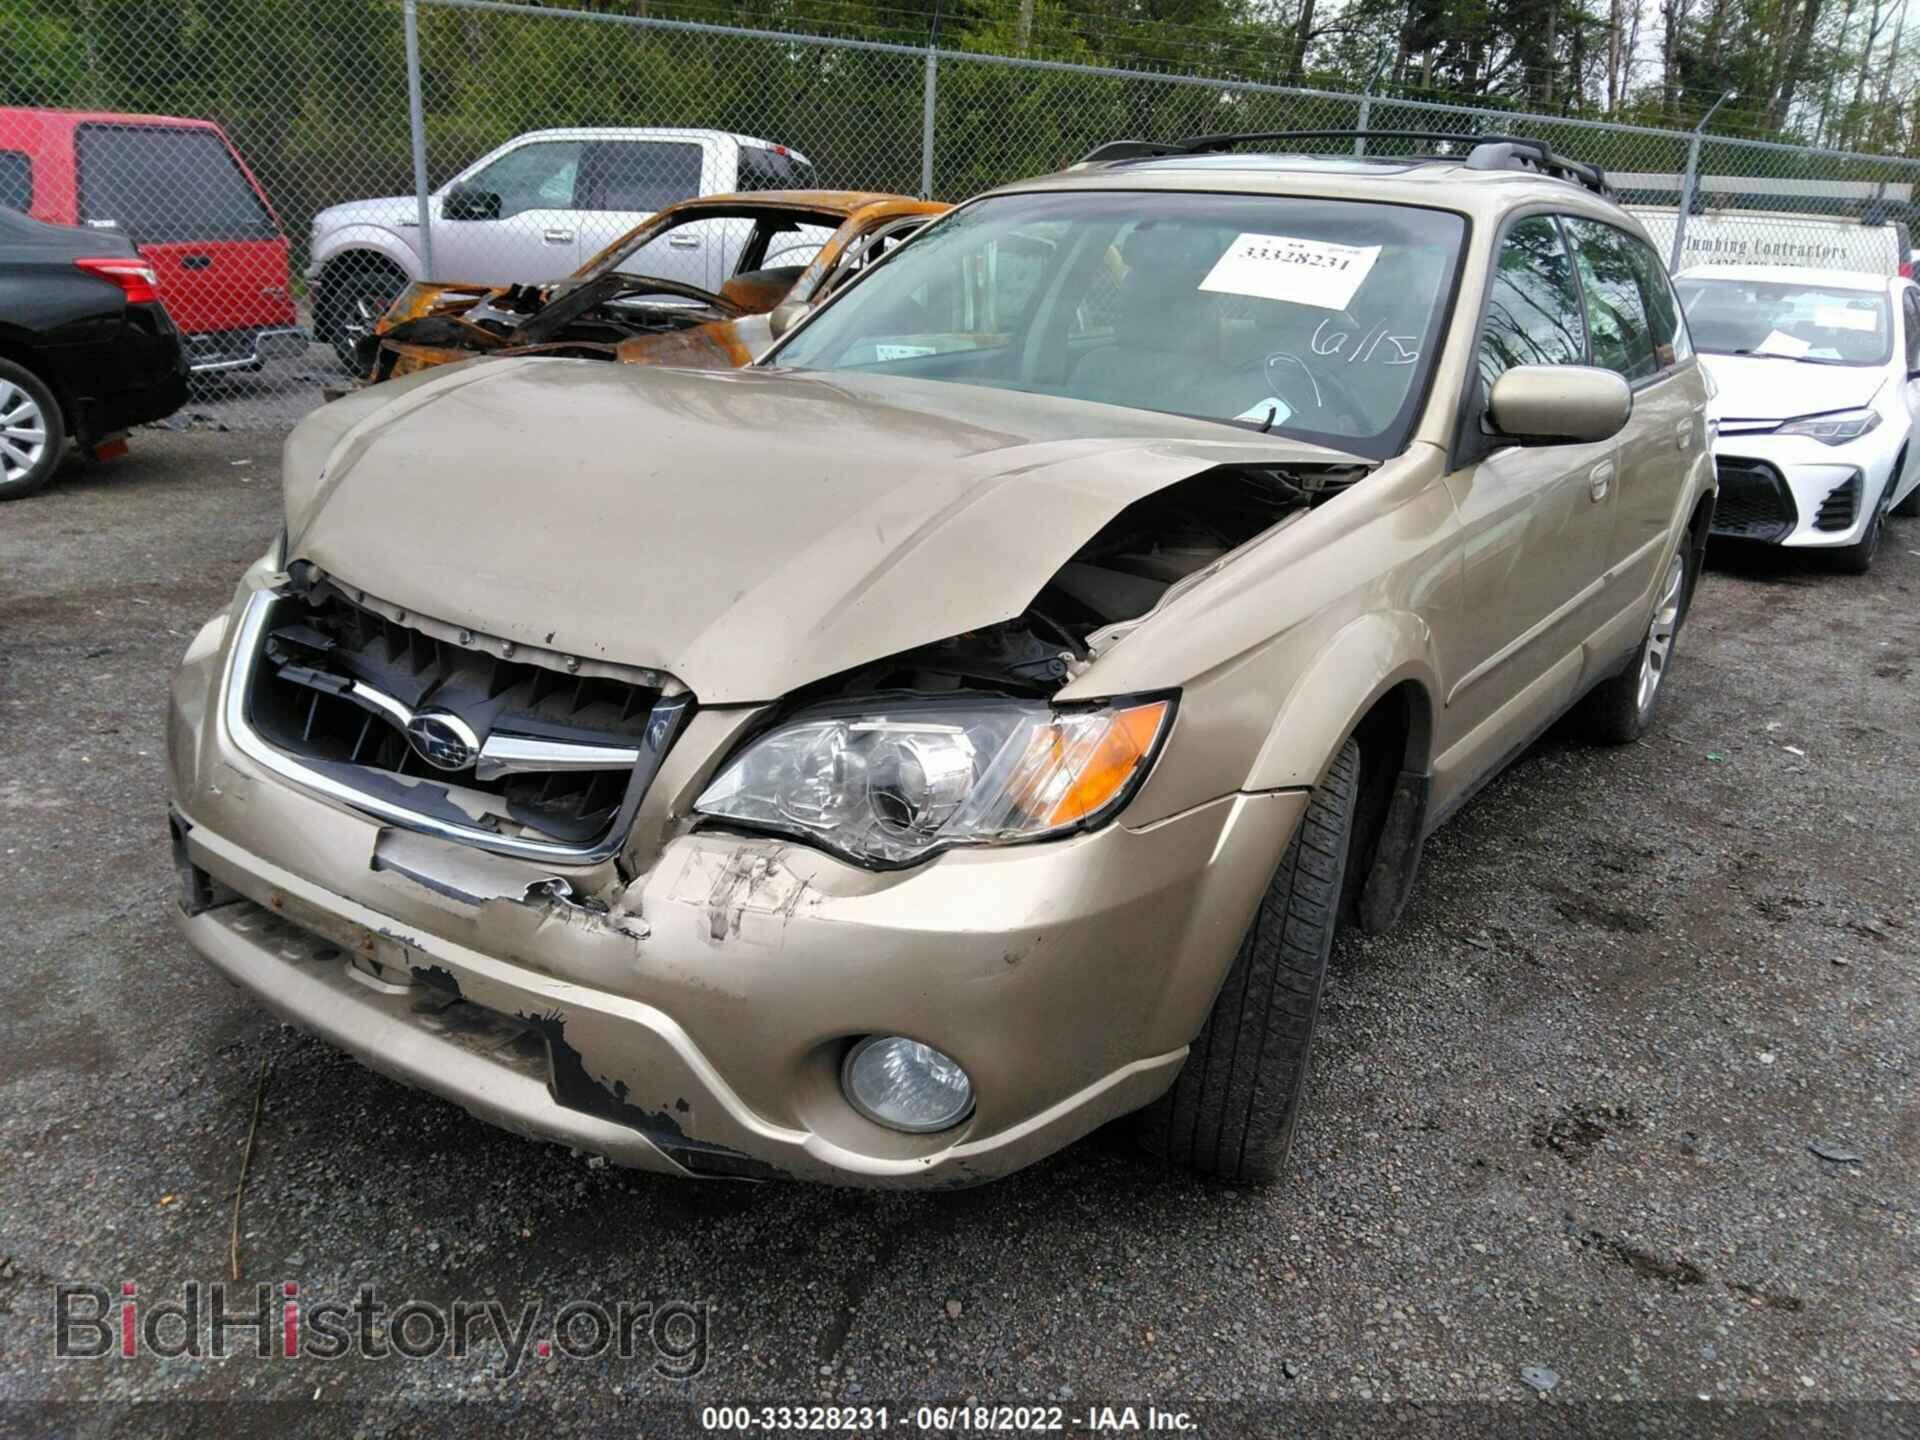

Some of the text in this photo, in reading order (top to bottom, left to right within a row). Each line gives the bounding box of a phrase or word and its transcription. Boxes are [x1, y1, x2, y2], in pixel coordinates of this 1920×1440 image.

[1237, 246, 1350, 271] 33328231
[1680, 234, 1847, 260] lumbing Contractors
